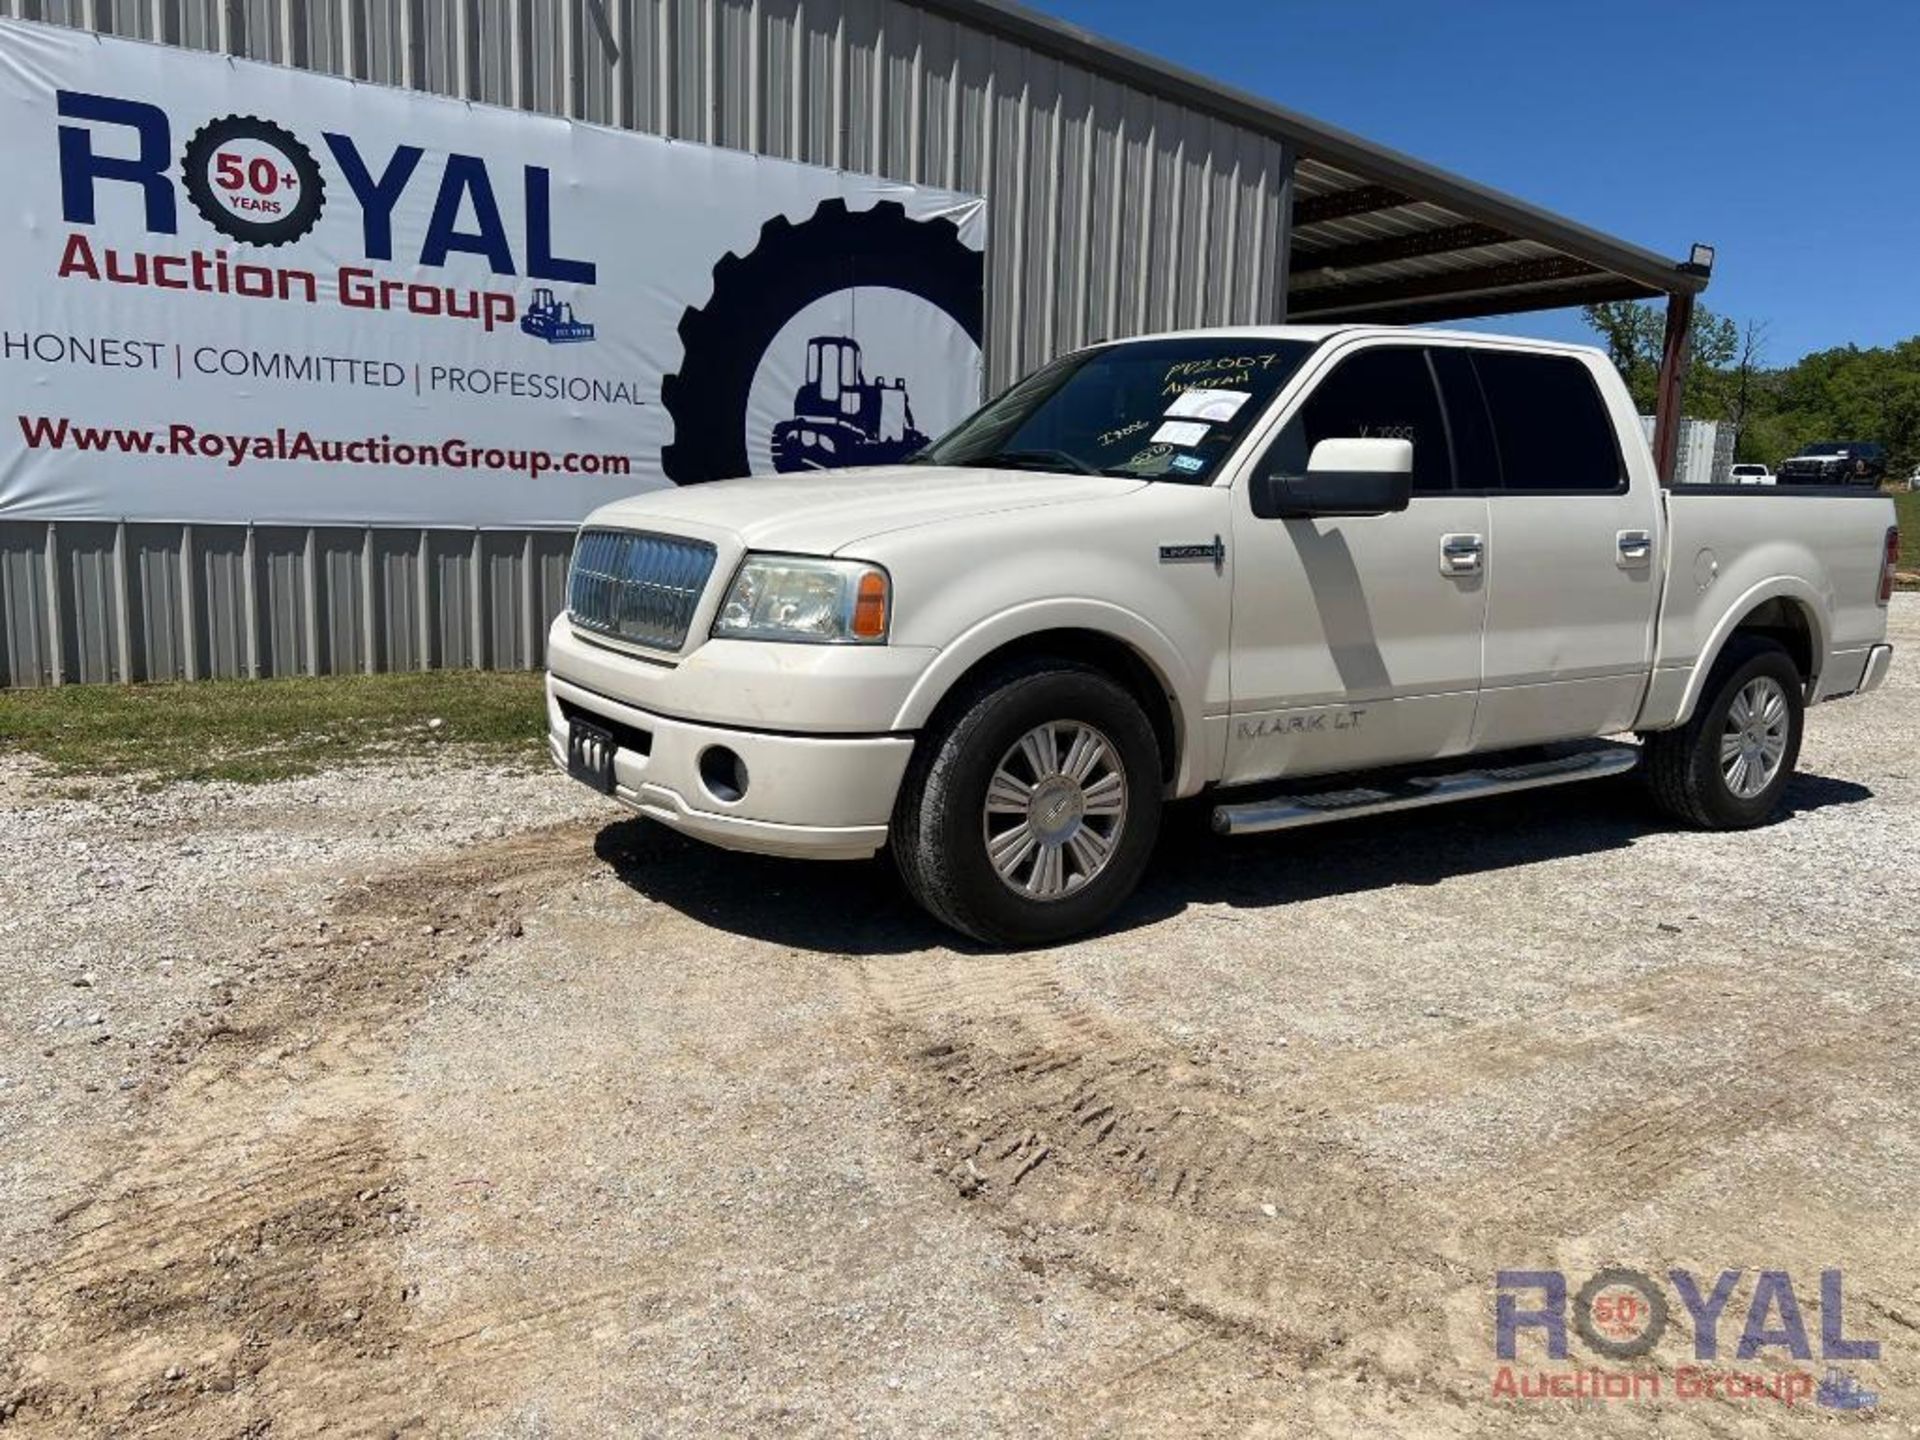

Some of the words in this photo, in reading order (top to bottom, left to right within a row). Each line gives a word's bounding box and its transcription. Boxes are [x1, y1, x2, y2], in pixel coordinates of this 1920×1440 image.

[56, 89, 597, 286] ROYAL
[215, 153, 297, 195] 50+
[230, 196, 282, 214] YEARS
[58, 233, 317, 302] Auction
[338, 266, 516, 332] Group
[4, 331, 166, 370] HONEST
[193, 347, 406, 388] COMMITTED
[431, 366, 646, 405] PROFESSIONAL
[18, 415, 631, 480] Www.RoyalAuctionGroup.com
[1238, 713, 1326, 738] MARK
[1334, 709, 1367, 730] LT
